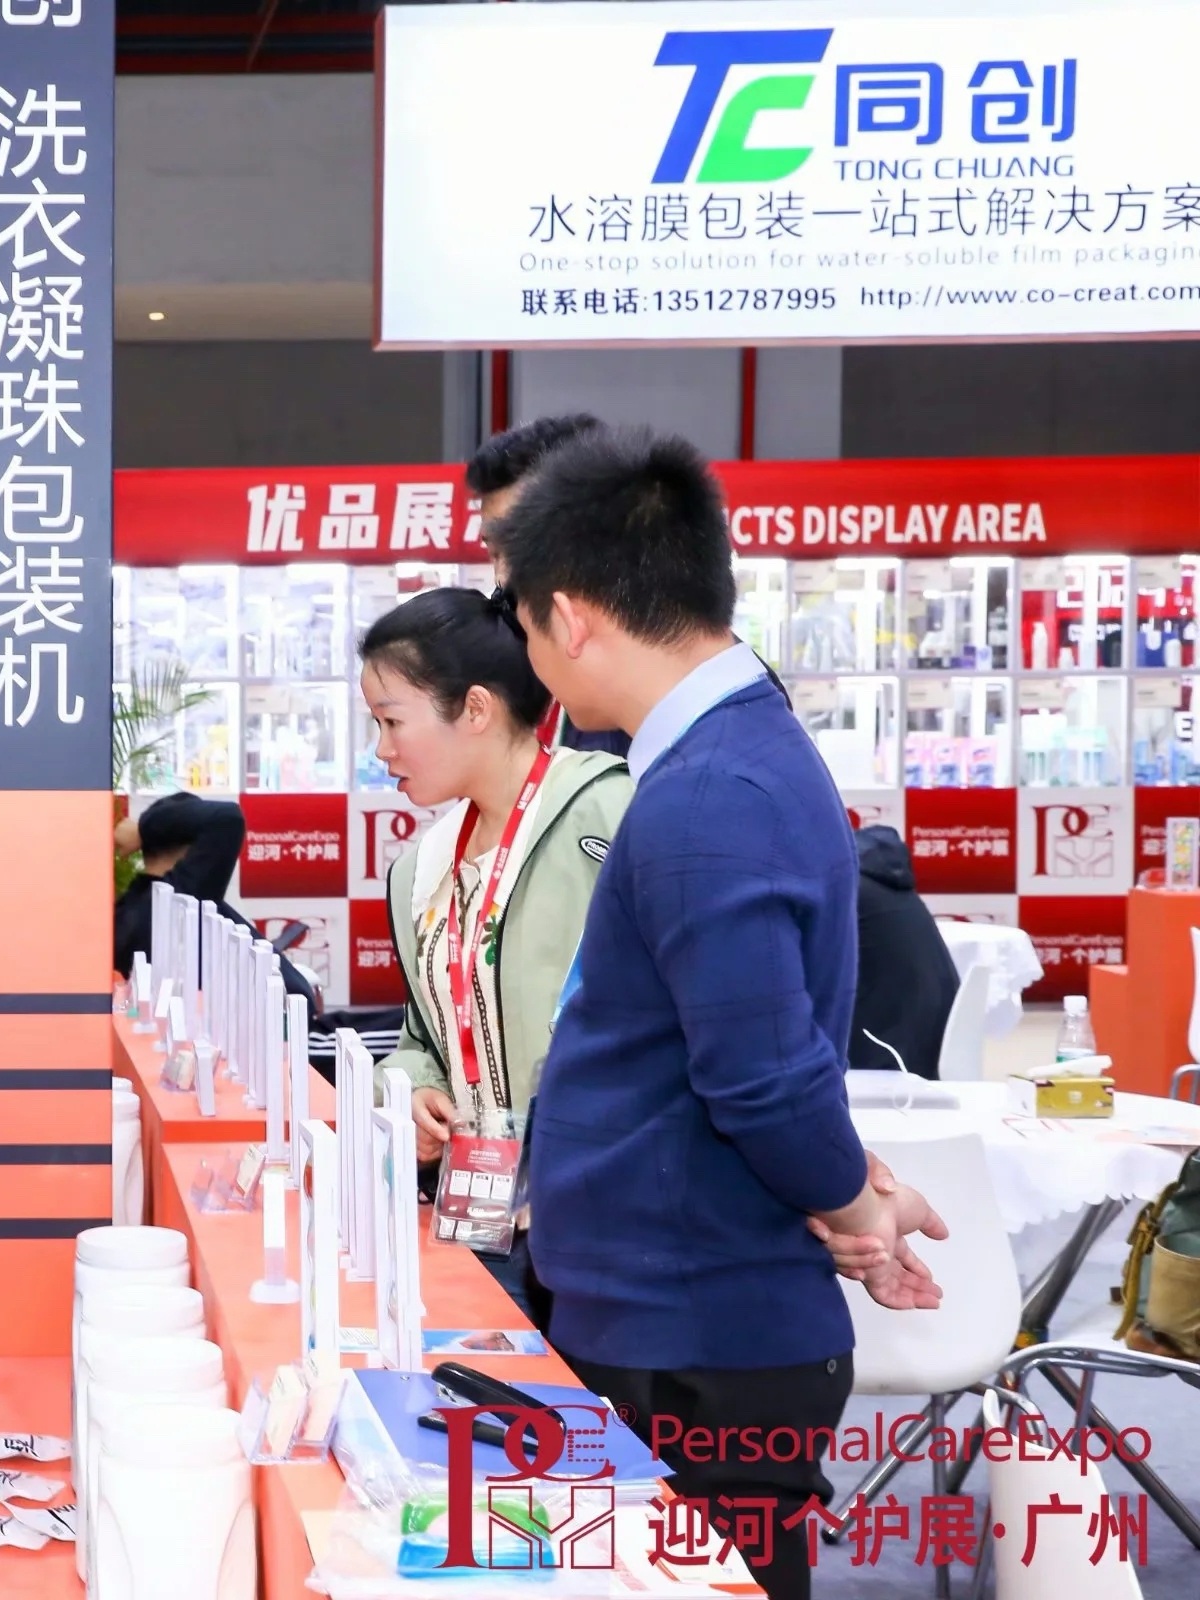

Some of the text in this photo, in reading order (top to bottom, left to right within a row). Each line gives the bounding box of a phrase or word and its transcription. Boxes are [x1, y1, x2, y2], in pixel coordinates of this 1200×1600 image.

[834, 58, 1077, 147] 同创
[834, 155, 1075, 182] TONG CHUANG
[528, 181, 1200, 243] 水溶膜包装一站式解决方案
[651, 250, 757, 271] solution
[770, 248, 806, 269] for
[1012, 244, 1062, 265] film
[1074, 242, 1200, 266] packagin
[725, 502, 1047, 546] CTS DISPLAY AREA
